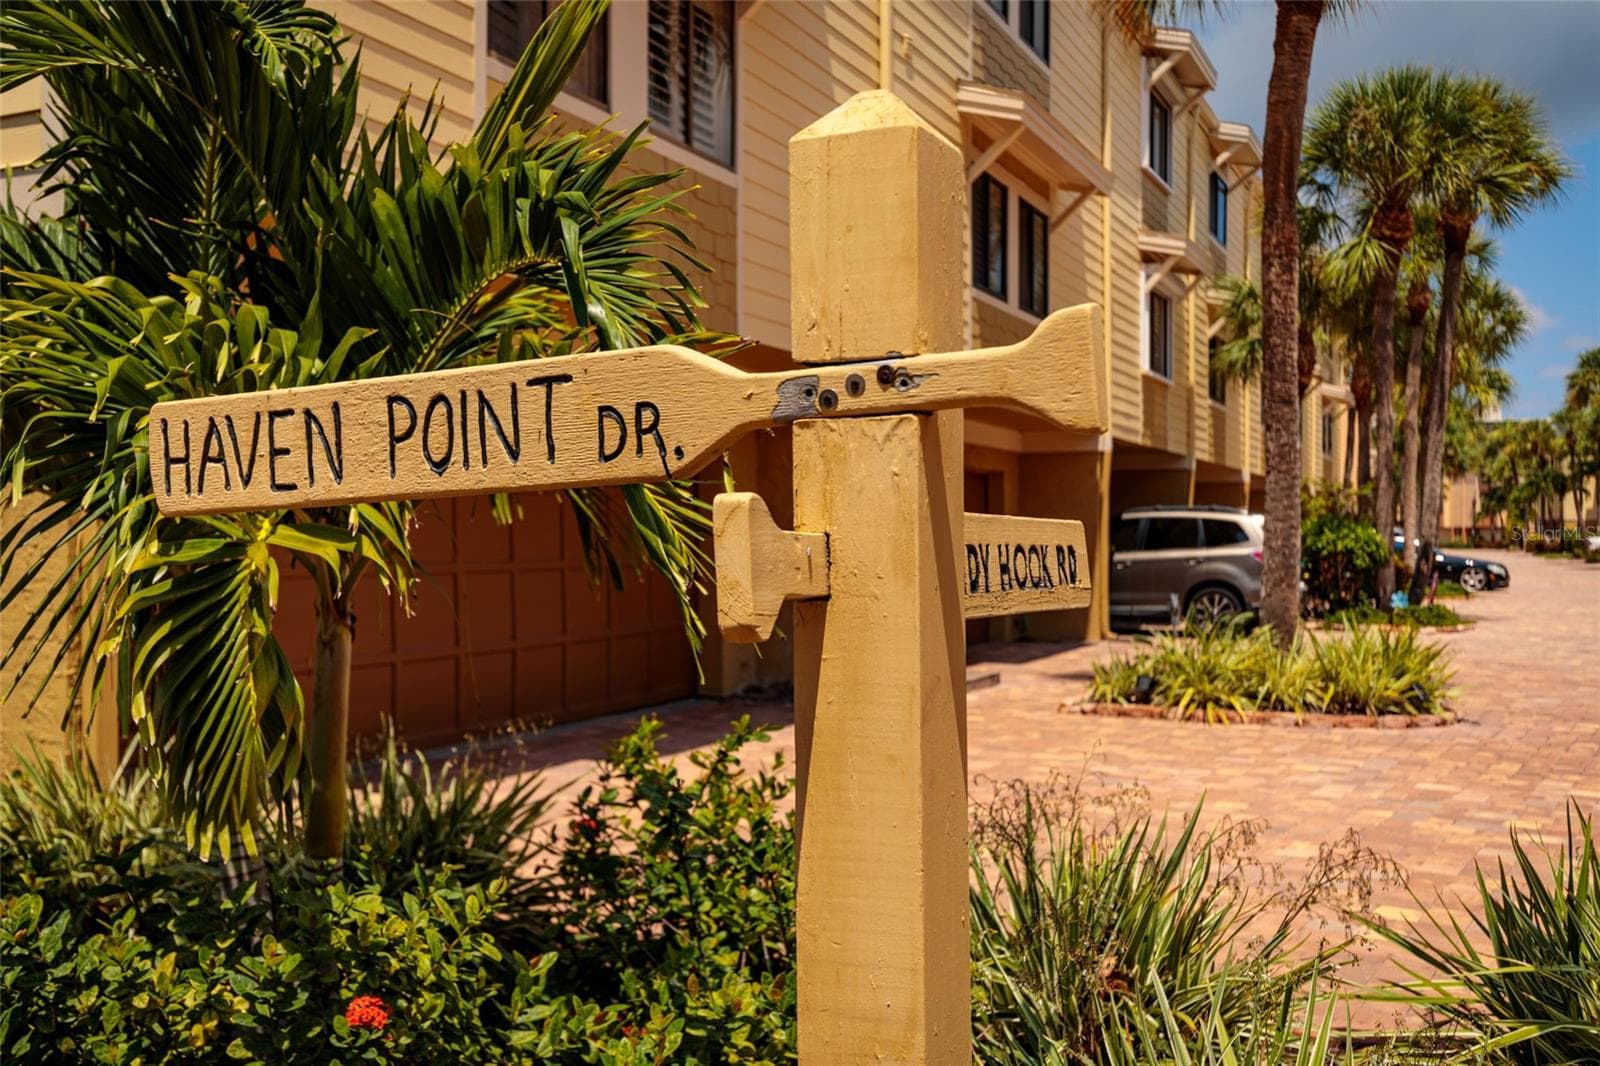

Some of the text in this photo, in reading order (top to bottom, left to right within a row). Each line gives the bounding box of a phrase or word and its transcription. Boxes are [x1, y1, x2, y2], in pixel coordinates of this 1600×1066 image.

[159, 373, 686, 496] HAVEN POINT DR.
[964, 543, 990, 595] DY
[997, 543, 1055, 592] HOOK
